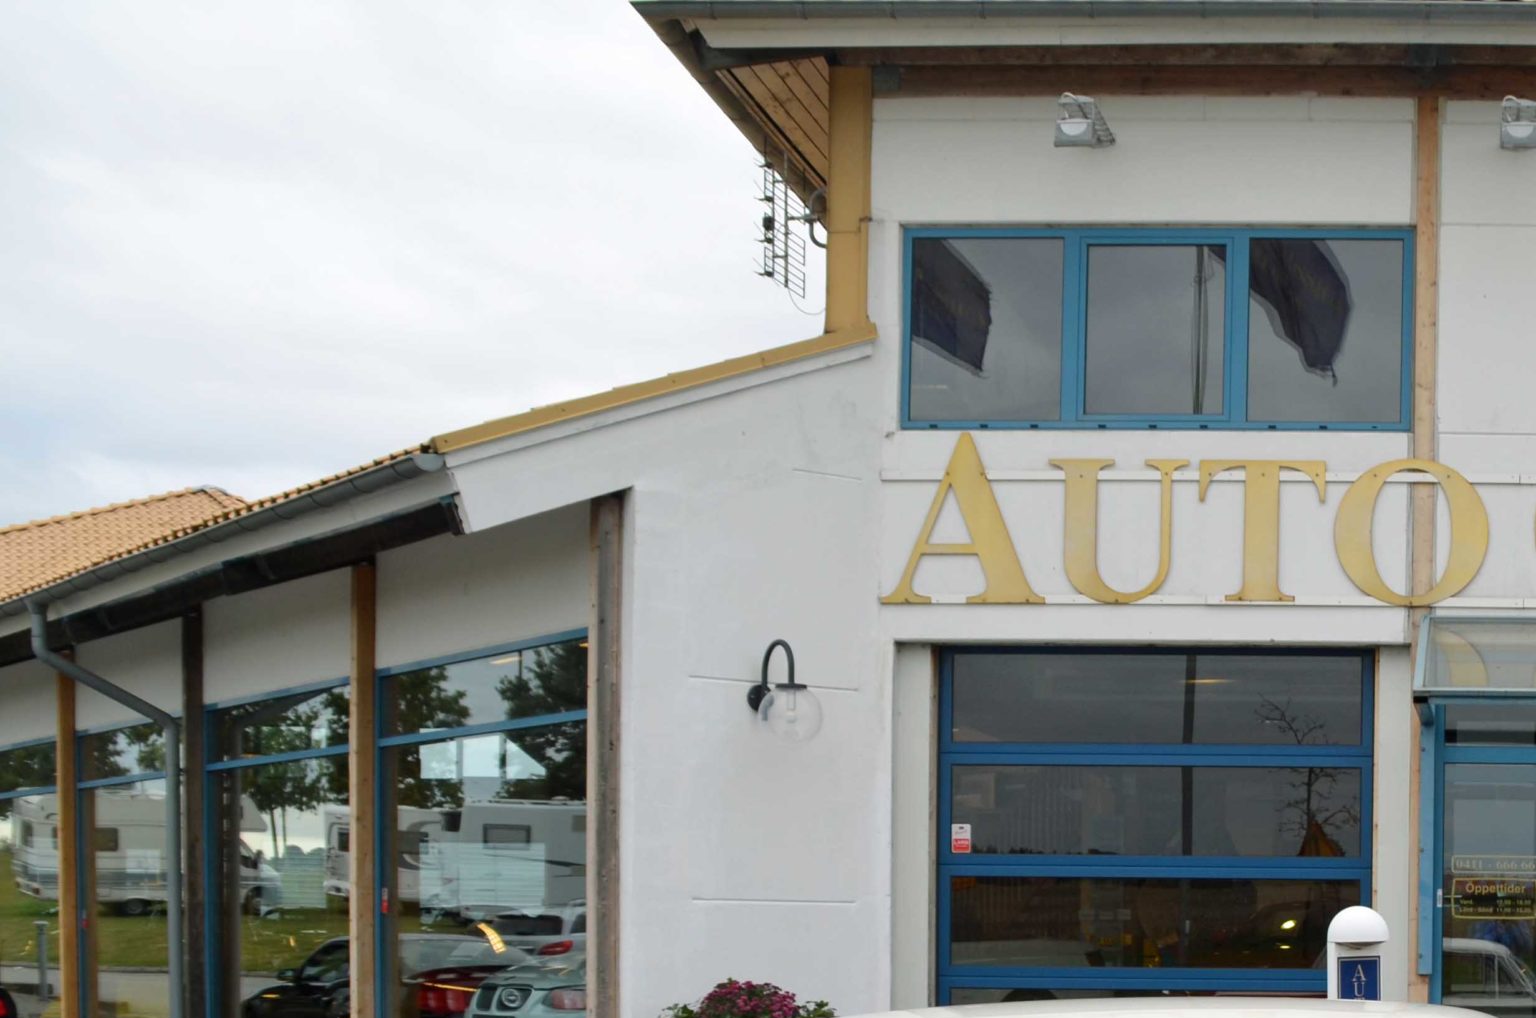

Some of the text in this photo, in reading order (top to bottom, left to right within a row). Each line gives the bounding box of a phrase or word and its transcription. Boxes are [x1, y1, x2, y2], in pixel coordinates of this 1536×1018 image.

[881, 432, 1489, 607] AUTO
[1465, 881, 1526, 895] Öppettider
[1352, 964, 1367, 1000] AU
